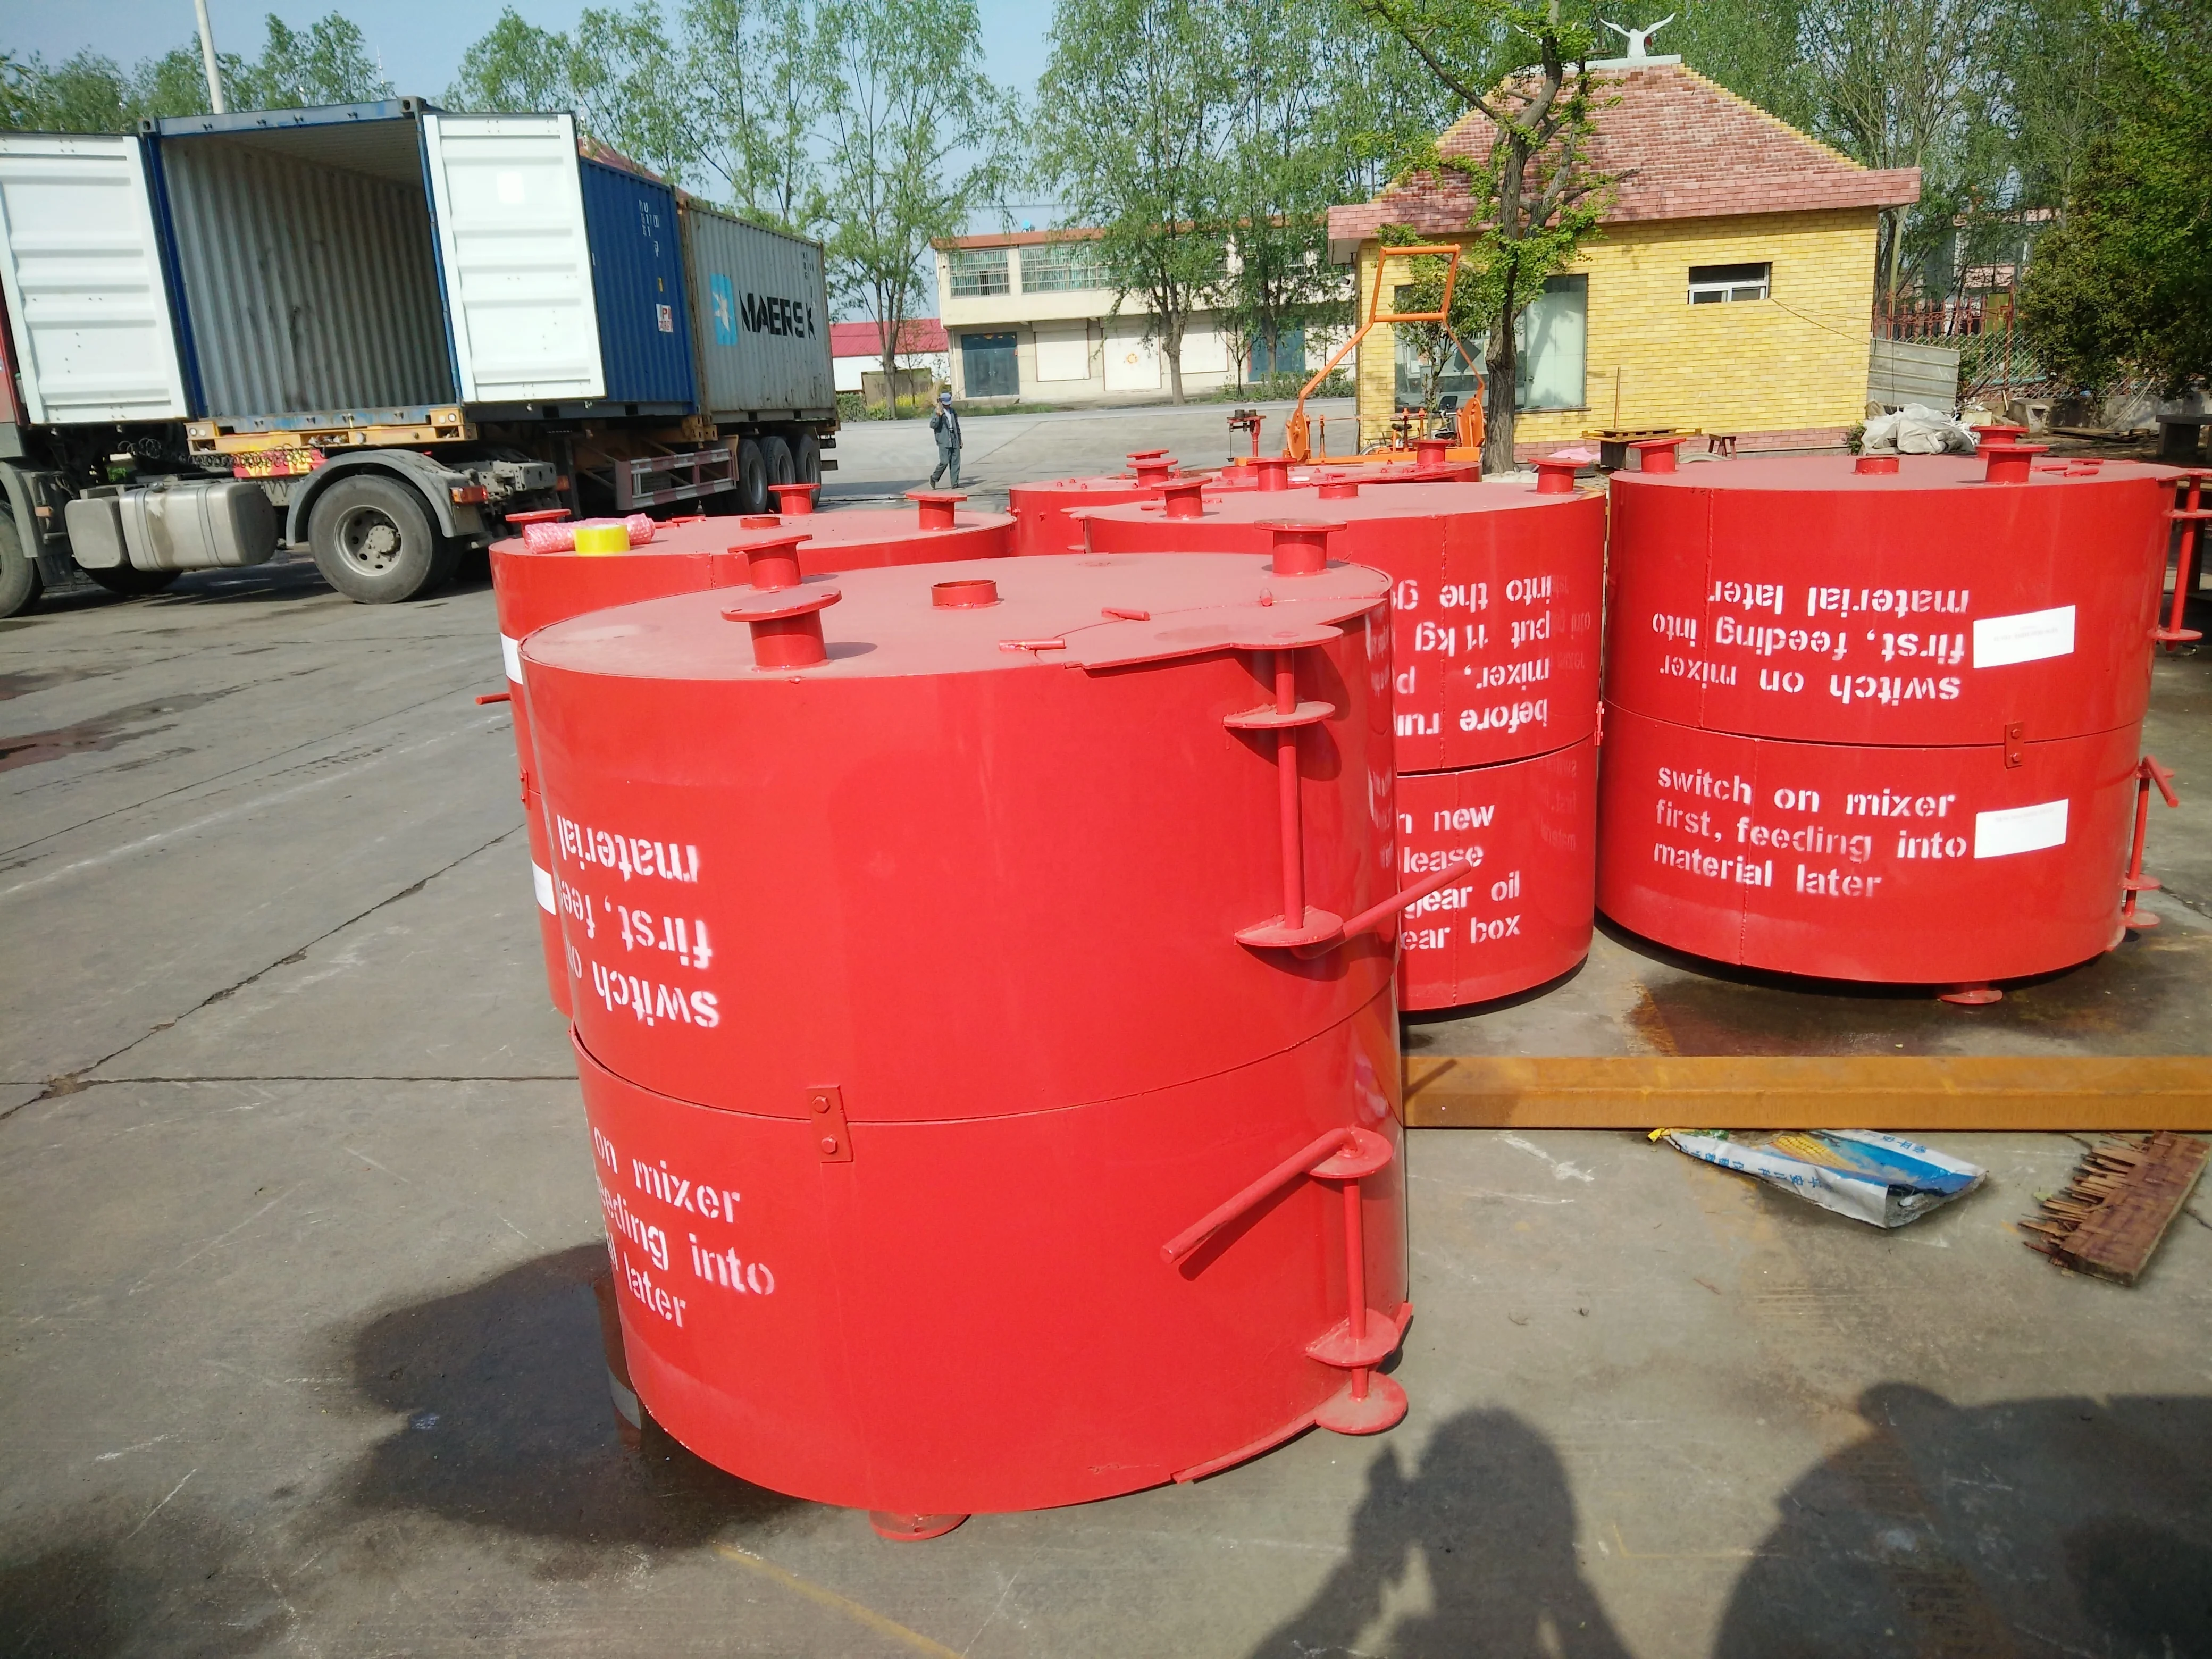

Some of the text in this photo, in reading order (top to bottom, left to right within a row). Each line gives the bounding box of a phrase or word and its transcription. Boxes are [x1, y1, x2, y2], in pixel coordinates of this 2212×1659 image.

[739, 290, 816, 340] MAERSK
[1439, 583, 1488, 613] the
[1506, 575, 1551, 606] into
[1708, 581, 1969, 618] material later
[1415, 621, 1455, 657] kg
[1511, 610, 1550, 649] put
[1652, 613, 1696, 647] into
[1716, 616, 1847, 661] feeding
[1866, 629, 1965, 664] first,
[1660, 655, 1960, 705] switch on mixer
[1460, 699, 1547, 733] before
[1658, 767, 1955, 817] switch on mixer
[1434, 805, 1495, 832] new
[1656, 799, 1966, 864] first, feeding into
[557, 814, 700, 883] material
[1653, 842, 1882, 896] material later
[1491, 870, 1520, 902] oil
[560, 880, 713, 969] first, fee
[1470, 914, 1520, 944] box
[592, 960, 719, 1028] switch
[594, 1126, 740, 1223] on mixer
[597, 1176, 774, 1295] eeding into
[624, 1251, 686, 1327] later
